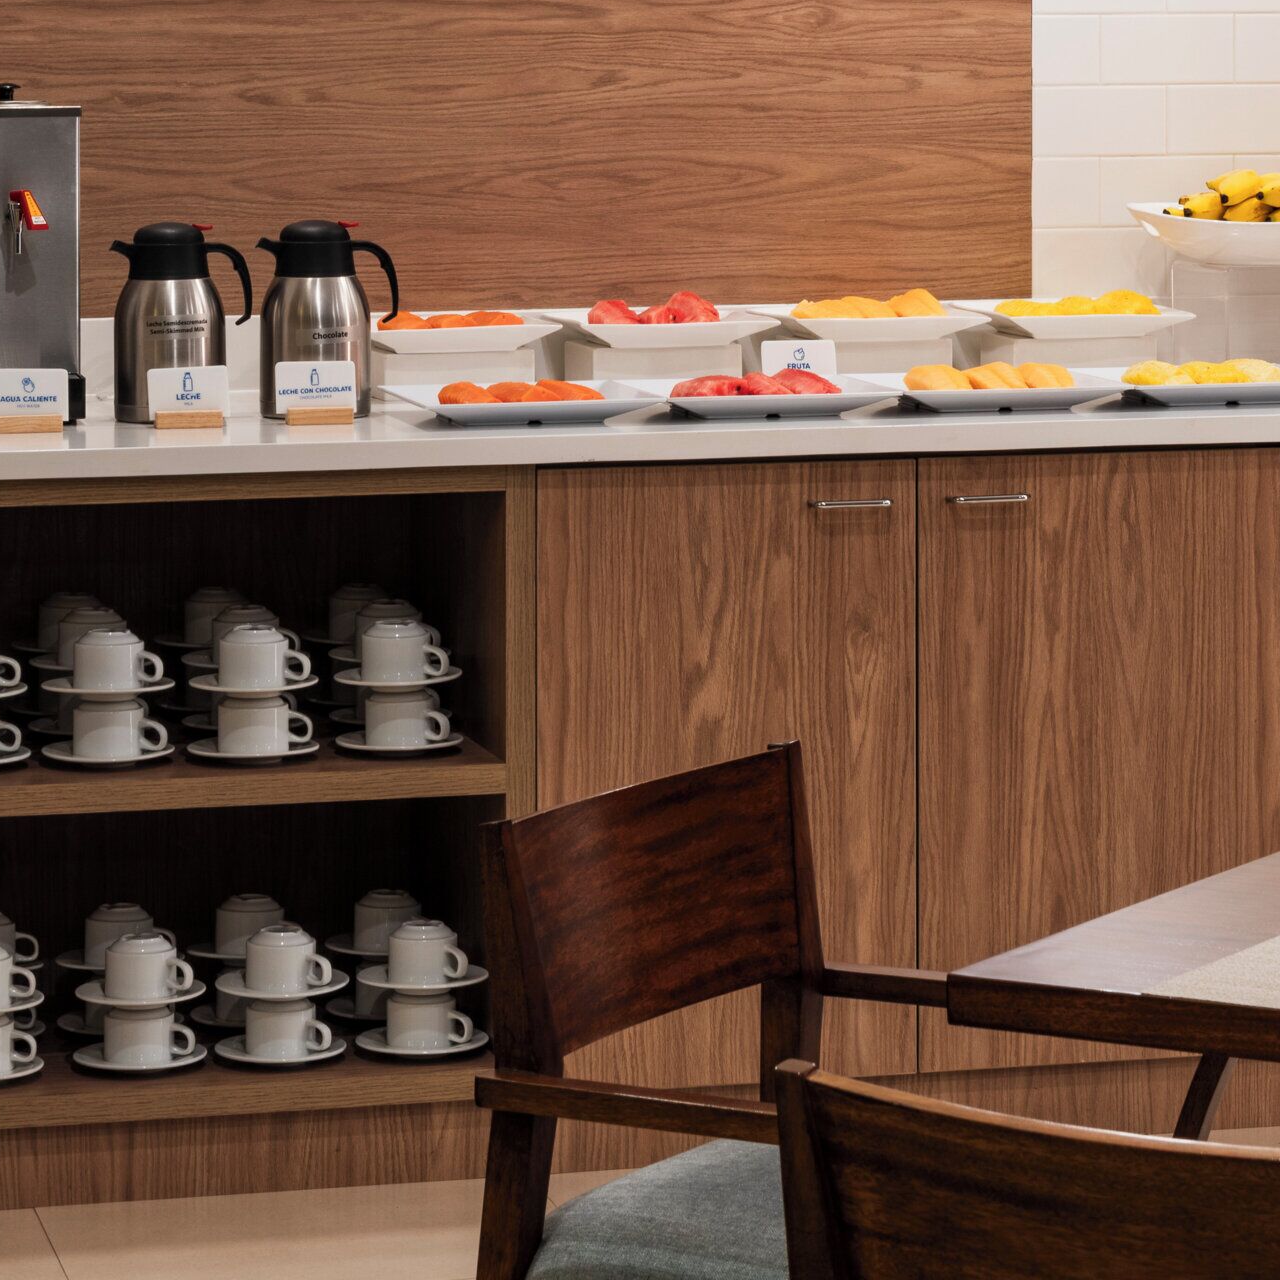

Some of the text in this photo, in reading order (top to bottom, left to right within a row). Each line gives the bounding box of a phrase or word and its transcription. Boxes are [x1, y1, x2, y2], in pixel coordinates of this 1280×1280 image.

[312, 331, 349, 340] Chocolate
[278, 385, 352, 396] LECHE CON CHOCOLATE
[0, 395, 57, 403] AGUA CALIENTE
